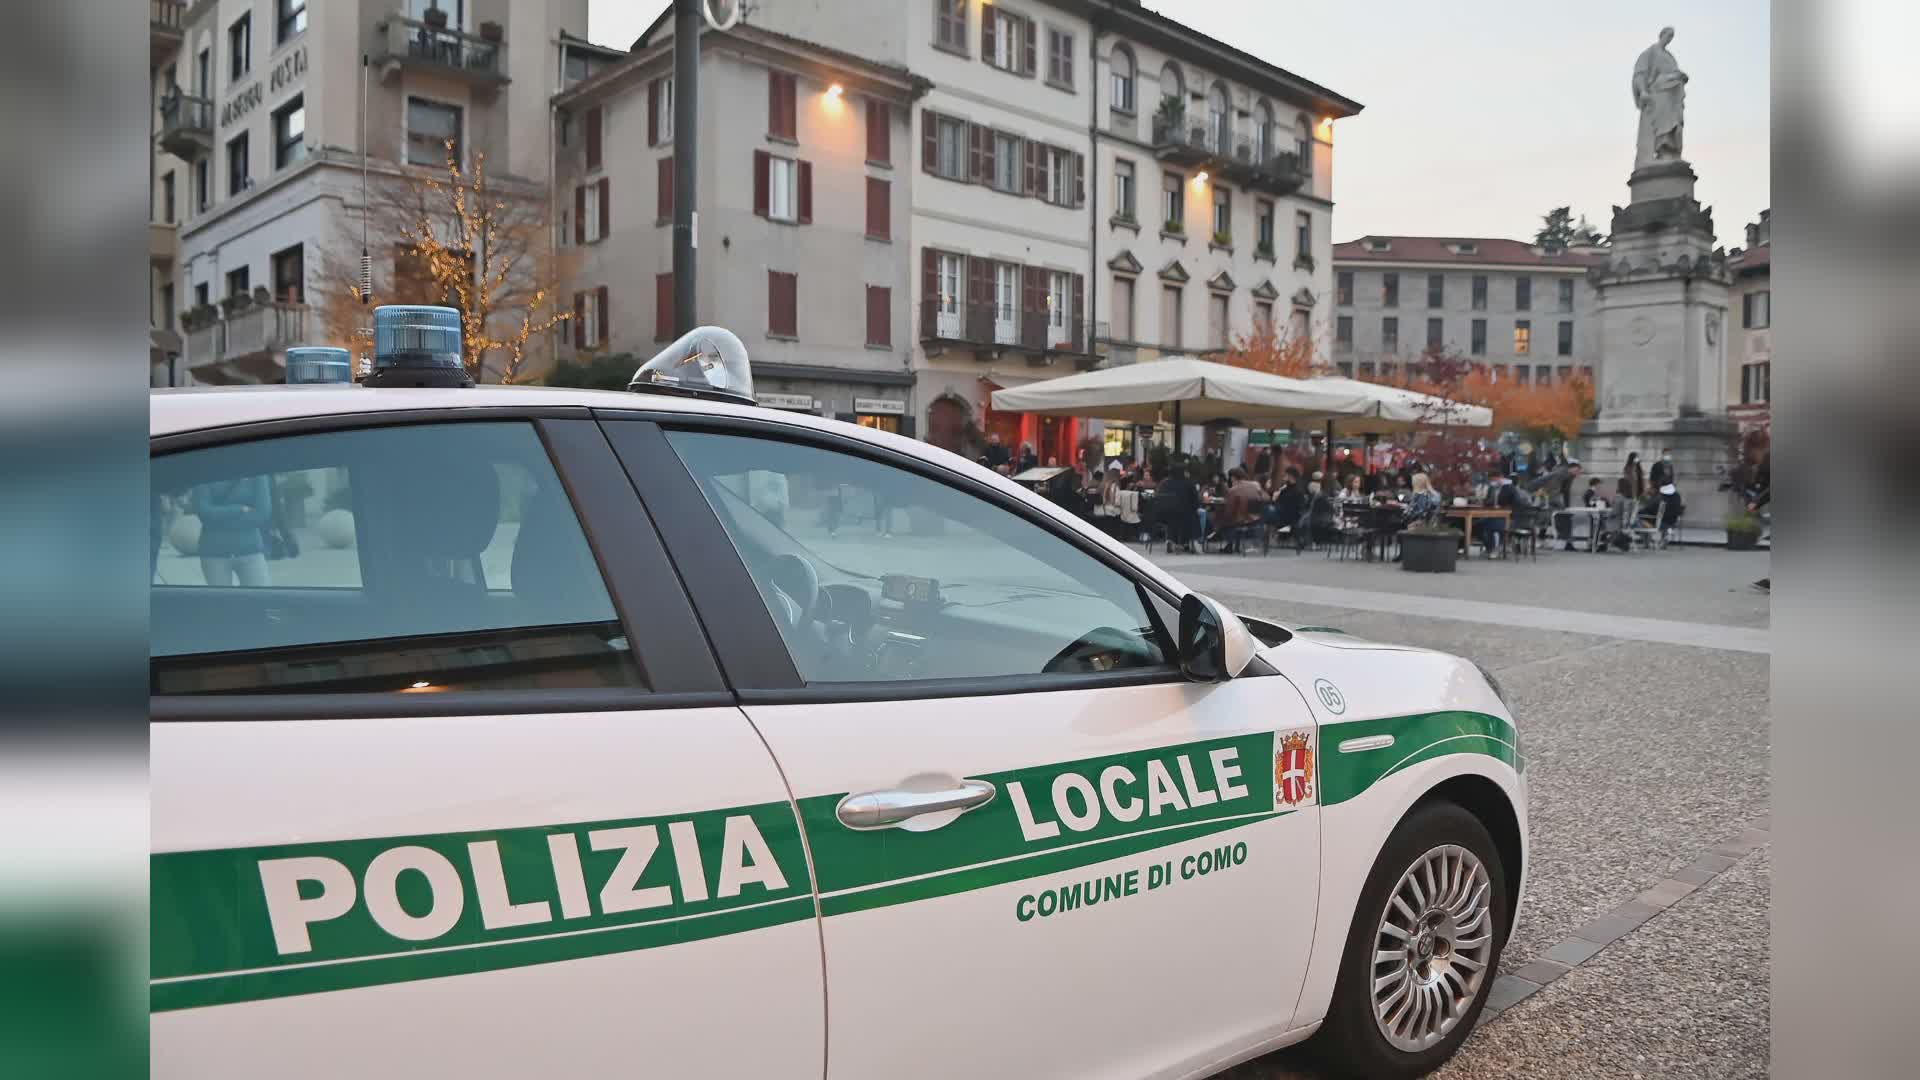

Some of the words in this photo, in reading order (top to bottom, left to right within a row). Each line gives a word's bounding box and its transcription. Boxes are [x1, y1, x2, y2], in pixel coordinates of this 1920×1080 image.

[1319, 686, 1341, 706] 05
[257, 815, 790, 955] POLIZIA
[1006, 747, 1249, 842] LOCALE
[1016, 870, 1139, 922] COMUNE
[1148, 861, 1172, 890] DI
[1180, 841, 1248, 880] COMO
